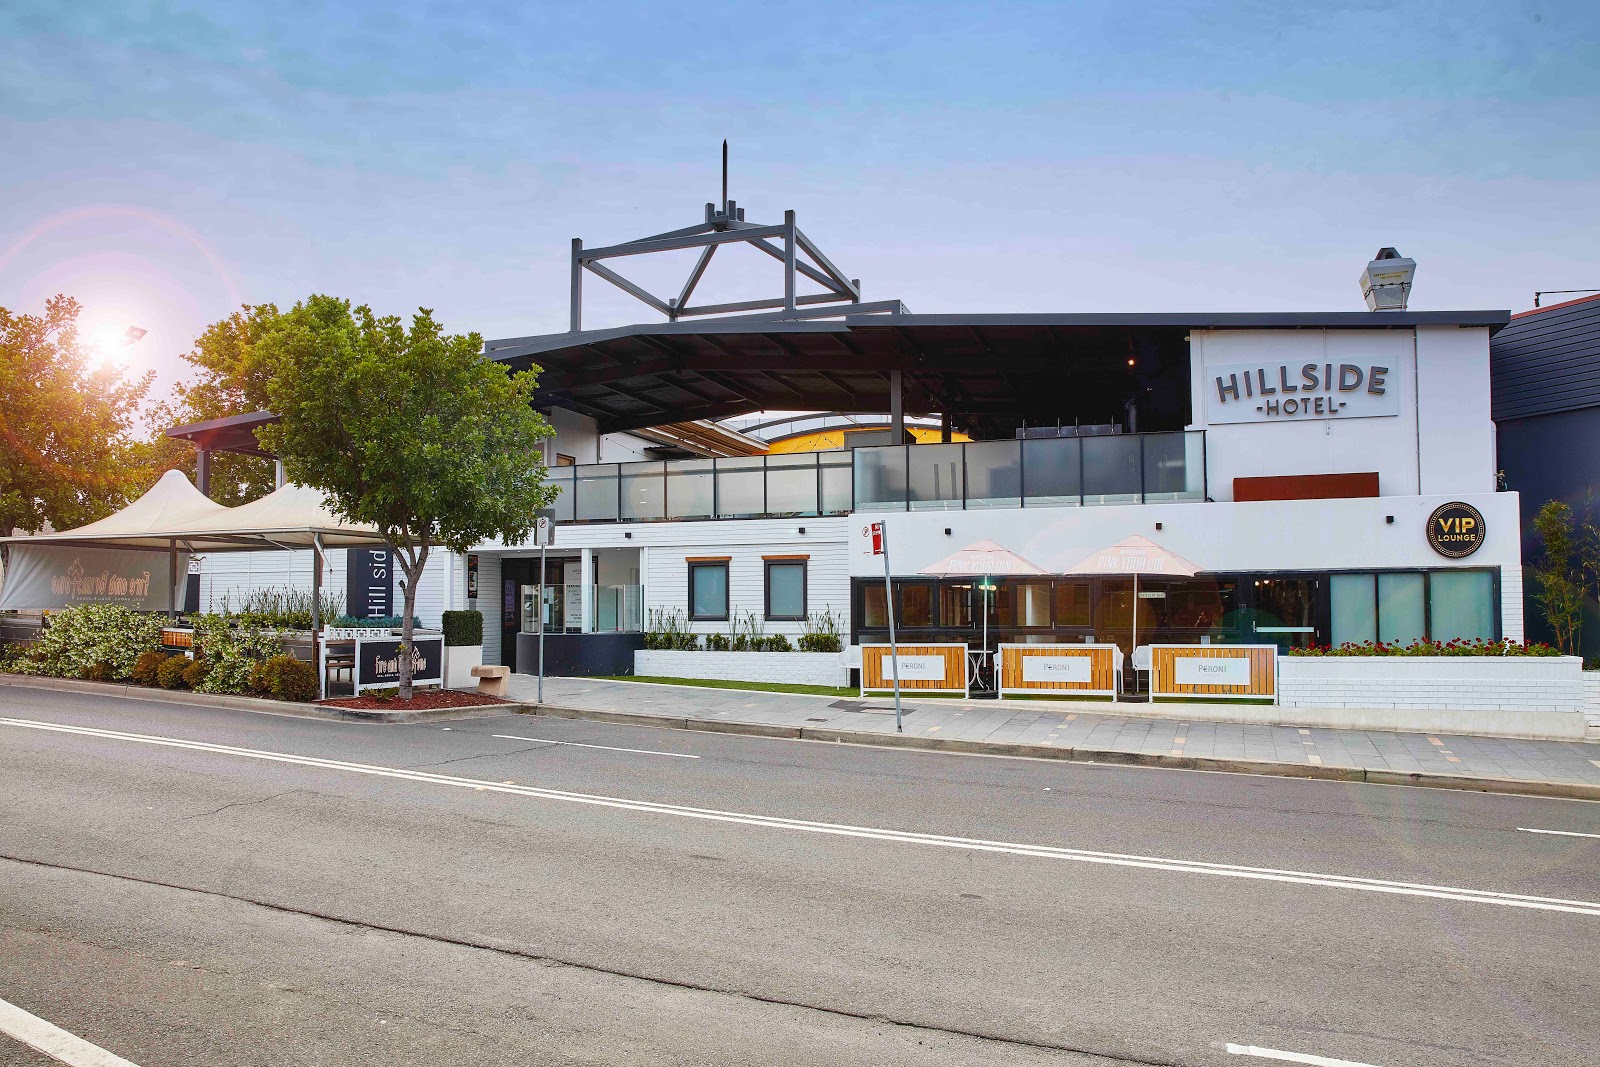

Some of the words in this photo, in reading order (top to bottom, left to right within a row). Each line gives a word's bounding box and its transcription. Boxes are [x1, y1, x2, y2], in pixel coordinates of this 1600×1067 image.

[1216, 363, 1389, 403] HILLSIDE
[1438, 517, 1475, 533] VIP
[1438, 534, 1476, 542] LOUNGE
[369, 550, 387, 579] sid
[948, 559, 968, 572] PINK
[971, 559, 994, 572] YOUR
[995, 559, 1011, 572] GIN
[1097, 555, 1120, 570] PINK
[1121, 556, 1146, 571] YOUR
[1147, 557, 1165, 571] GIN
[368, 586, 386, 617] Hill
[901, 662, 926, 670] PERONI
[1043, 663, 1070, 671] PERONI
[1198, 664, 1227, 673] PERONI
